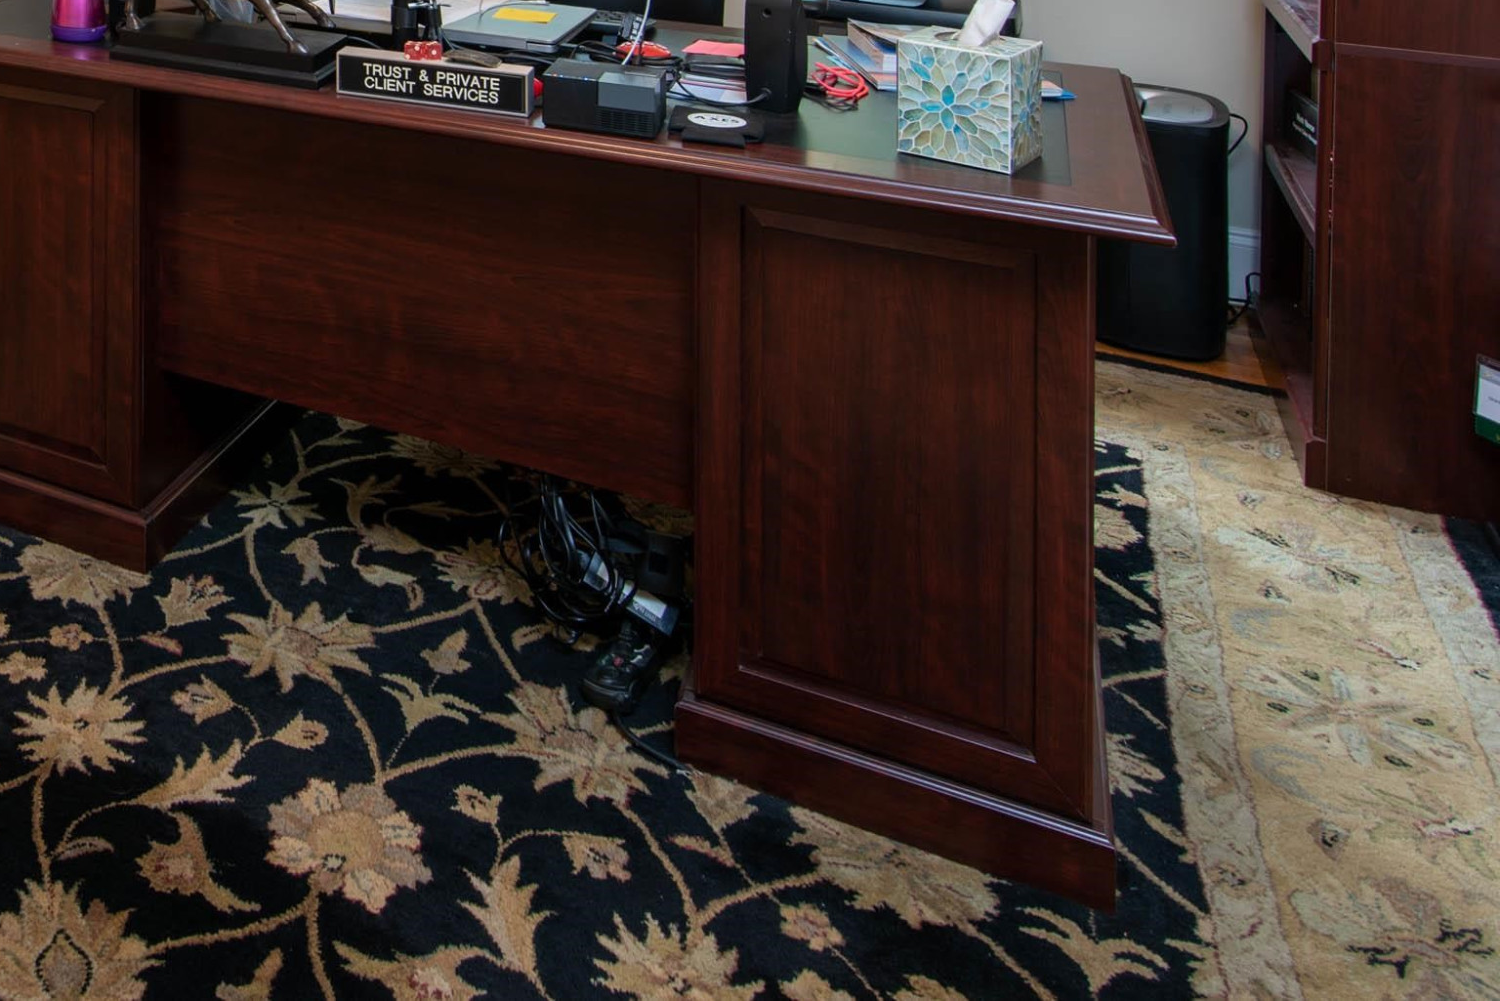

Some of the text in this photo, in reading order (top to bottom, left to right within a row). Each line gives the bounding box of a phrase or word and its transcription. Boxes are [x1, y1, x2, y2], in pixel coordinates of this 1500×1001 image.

[363, 62, 500, 91] TRUST & PRIVATE
[364, 76, 499, 104] CLIENT SERVICES
